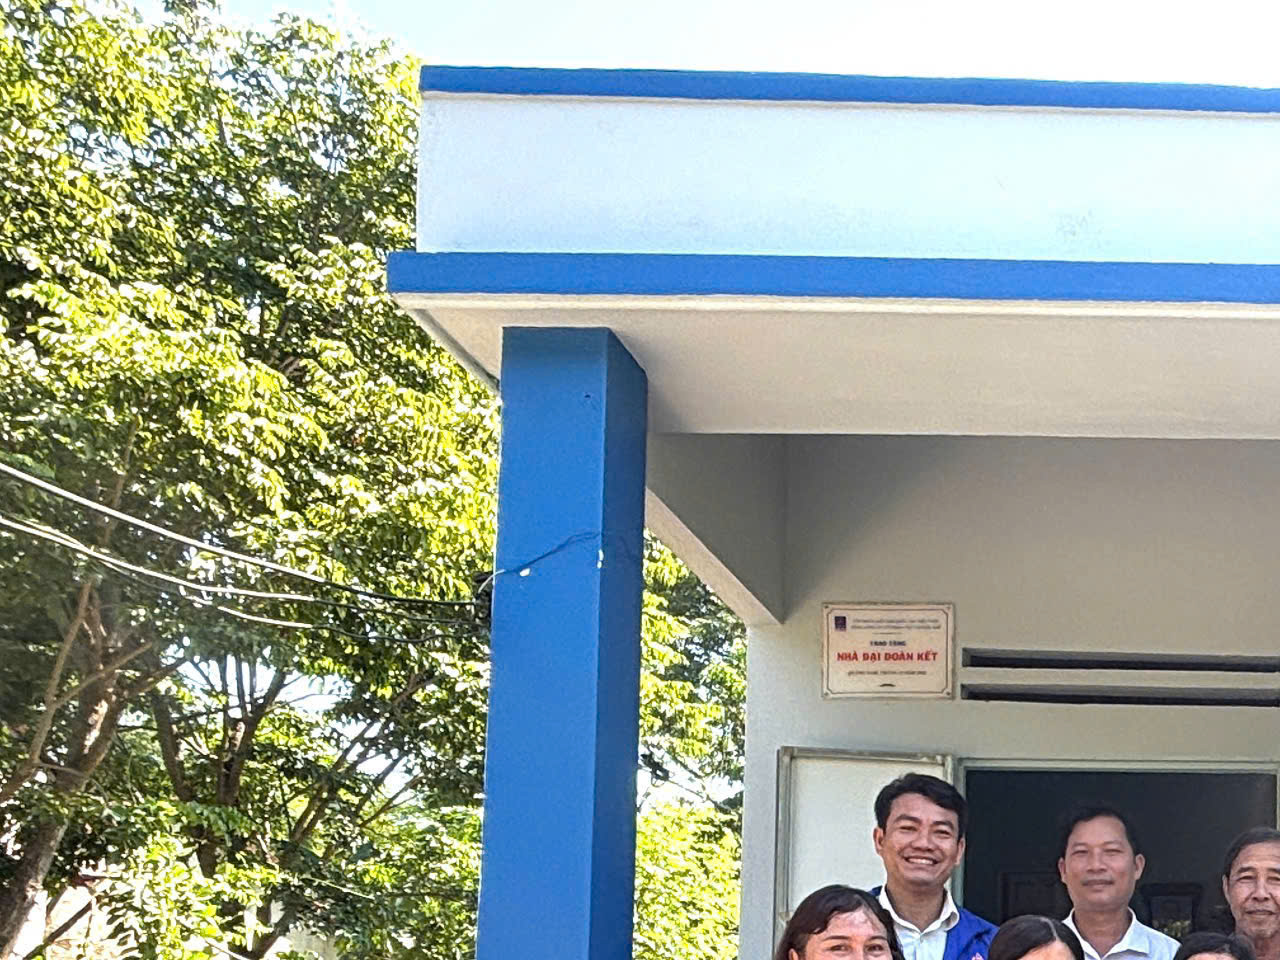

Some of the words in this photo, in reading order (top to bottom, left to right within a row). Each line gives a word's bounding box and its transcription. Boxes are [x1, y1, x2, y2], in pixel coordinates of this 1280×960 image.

[837, 650, 858, 662] NHÀ
[862, 651, 881, 663] ĐẠI
[917, 648, 938, 662] KẾT
